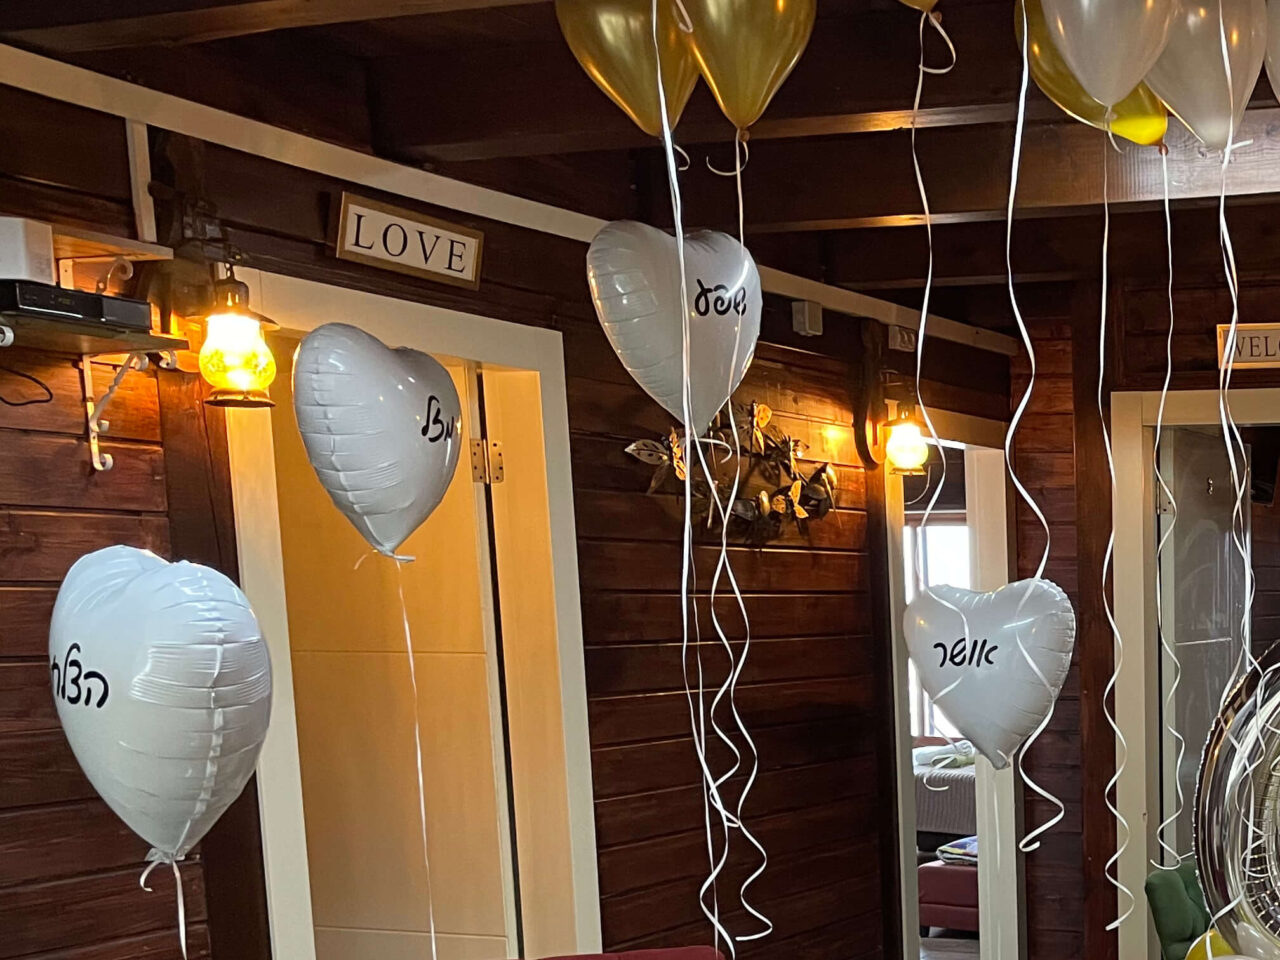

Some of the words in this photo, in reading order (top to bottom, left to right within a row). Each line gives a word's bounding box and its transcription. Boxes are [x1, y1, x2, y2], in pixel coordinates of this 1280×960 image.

[351, 212, 467, 274] LOVE
[694, 278, 747, 317] שפע
[51, 642, 109, 708] הצלח
[933, 637, 999, 668] אושר
